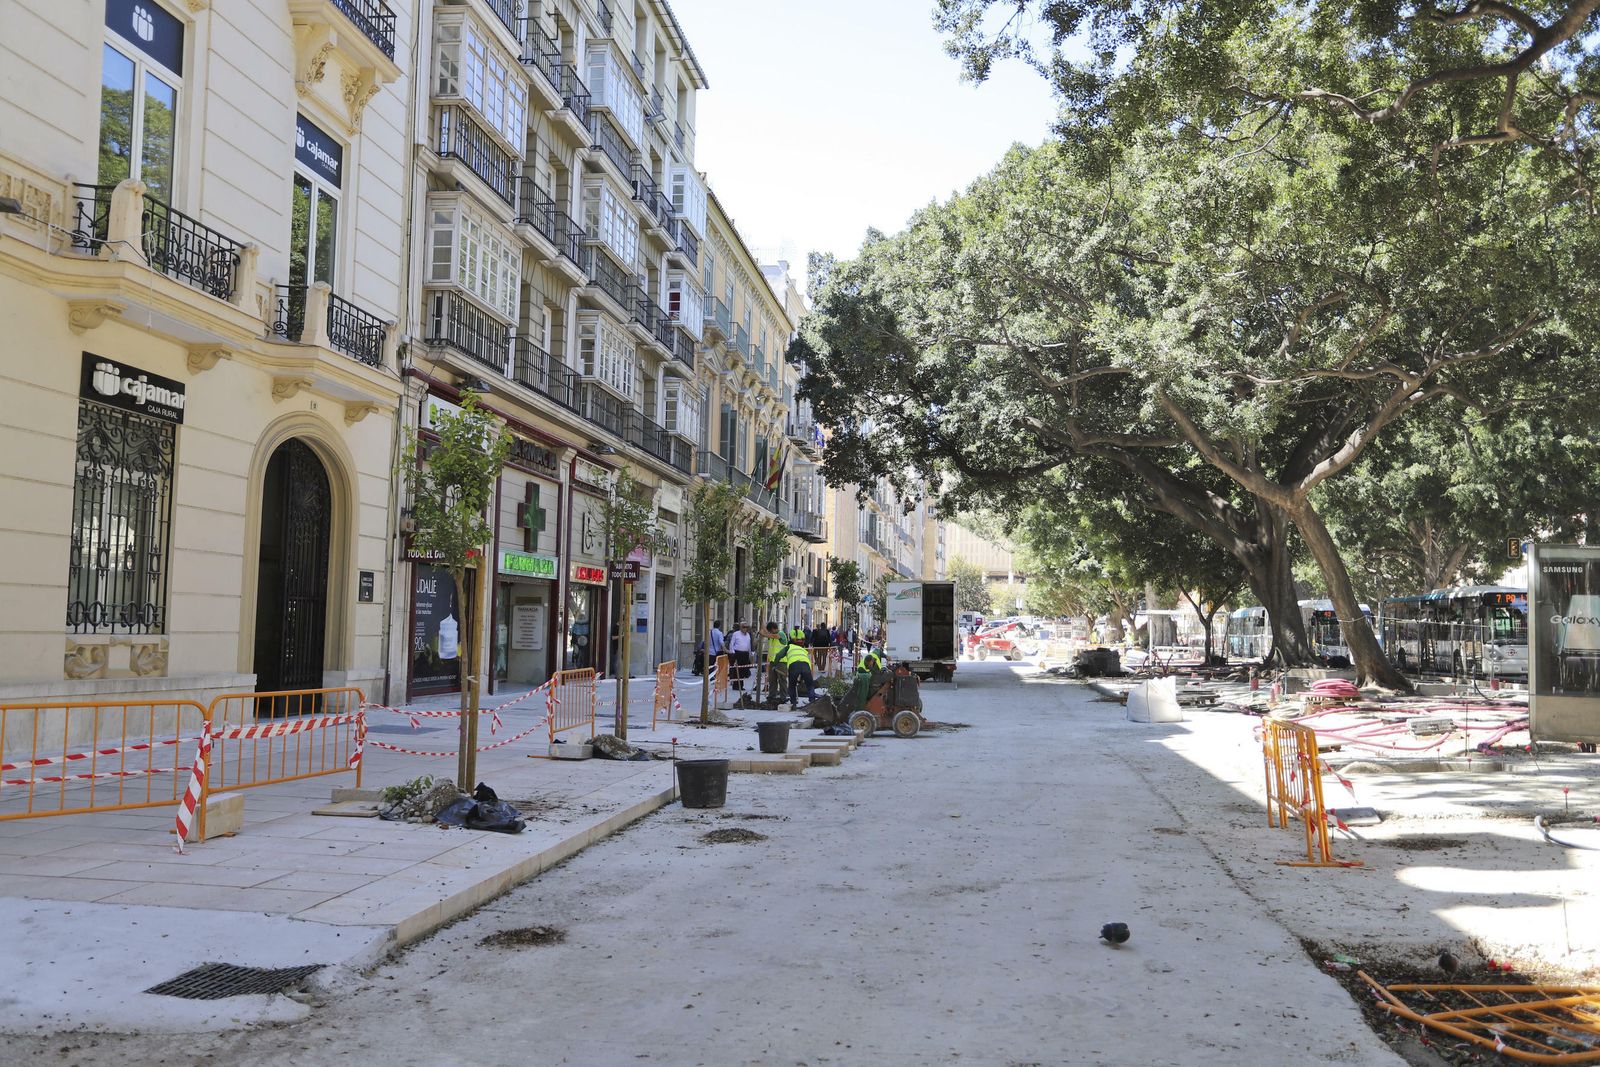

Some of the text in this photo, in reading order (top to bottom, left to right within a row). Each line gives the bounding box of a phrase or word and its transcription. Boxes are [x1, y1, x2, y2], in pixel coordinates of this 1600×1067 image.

[306, 140, 338, 170] cajamar
[120, 375, 185, 409] cajamar
[147, 404, 178, 420] CAJA RURAL
[1496, 594, 1501, 603] 7
[1550, 614, 1600, 628] Galaxy
